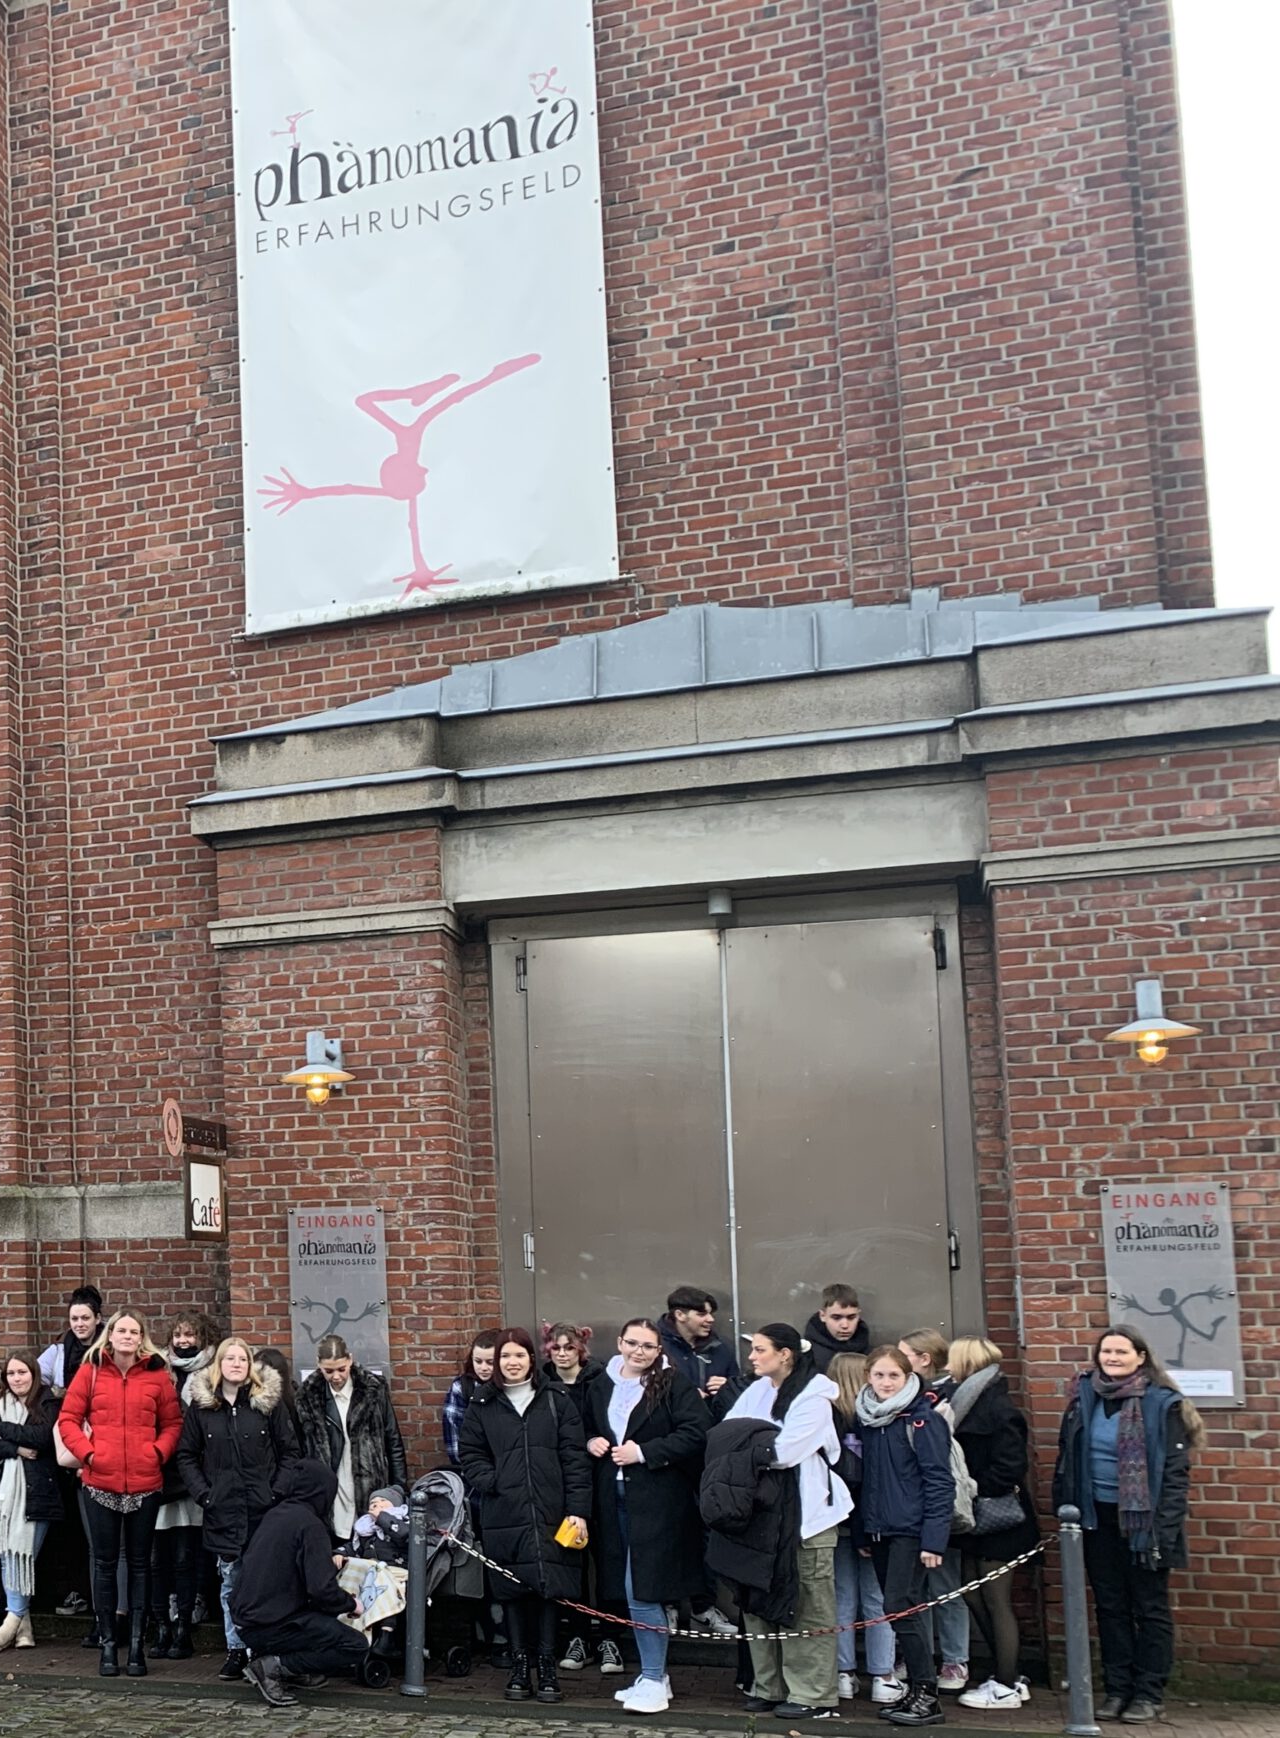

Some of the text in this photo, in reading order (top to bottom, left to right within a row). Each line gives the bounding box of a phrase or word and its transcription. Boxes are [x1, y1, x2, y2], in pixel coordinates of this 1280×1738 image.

[254, 97, 579, 222] phänomania
[256, 164, 582, 254] ERFAHRUNGSFELD
[1112, 1191, 1218, 1209] EINGANG
[191, 1197, 221, 1227] Café
[297, 1214, 376, 1228] EINGANG
[1116, 1242, 1221, 1253] ERFAHRUNGSFELD
[298, 1257, 377, 1267] ERFAHRUNGSFELD
